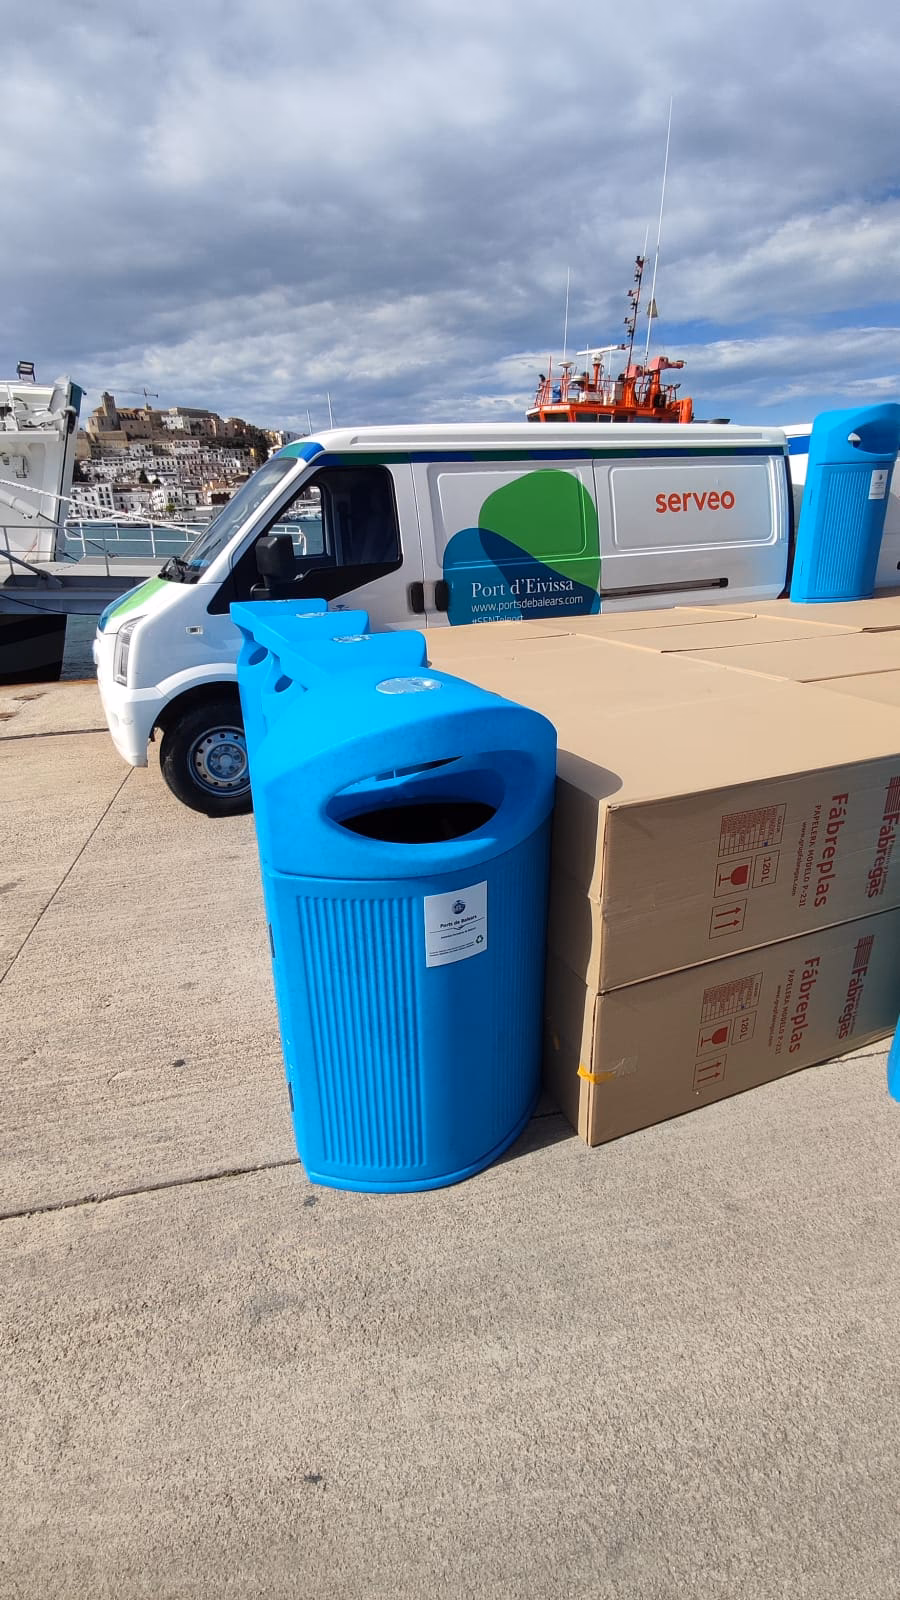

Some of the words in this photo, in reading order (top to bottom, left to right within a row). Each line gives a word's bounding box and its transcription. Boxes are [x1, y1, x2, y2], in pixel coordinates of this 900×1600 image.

[655, 490, 735, 514] serveo
[471, 582, 506, 598] Port
[509, 577, 574, 595] d'Eivissa
[471, 595, 584, 613] www.portsdebalears.com
[808, 804, 822, 847] PAPELERA
[803, 849, 815, 883] MODELO
